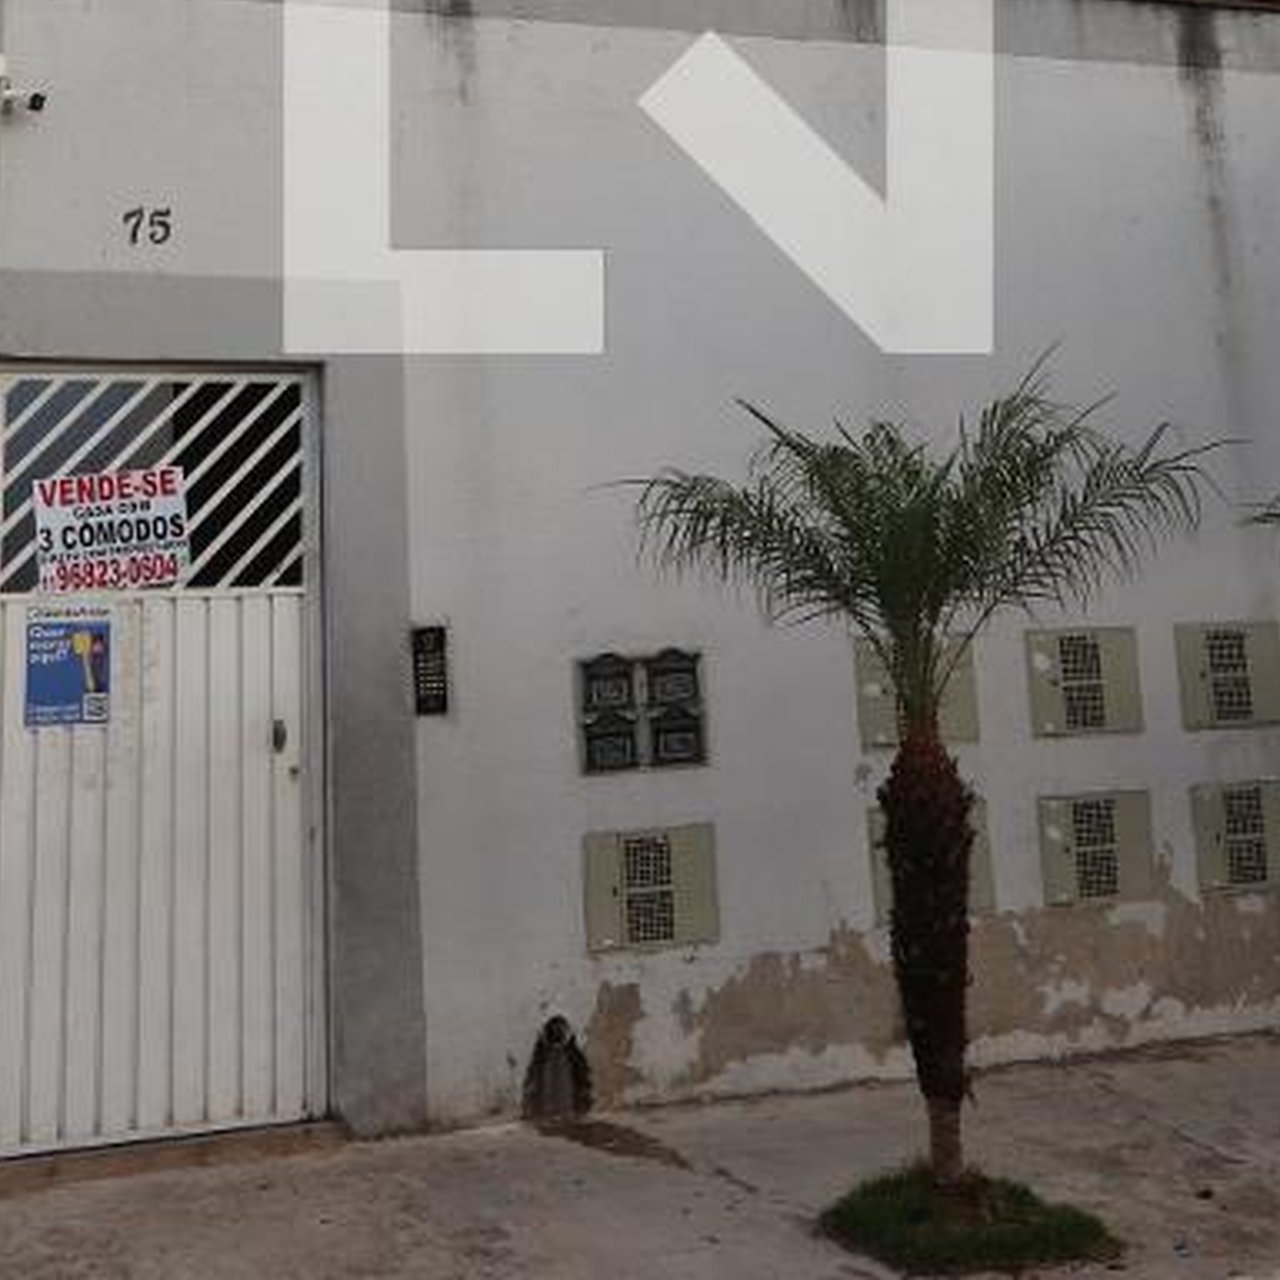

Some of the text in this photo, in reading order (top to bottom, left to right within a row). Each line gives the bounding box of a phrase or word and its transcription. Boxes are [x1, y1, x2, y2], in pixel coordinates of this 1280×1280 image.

[122, 206, 171, 246] 75
[39, 469, 177, 508] VENDE-SE
[39, 528, 54, 552] 3
